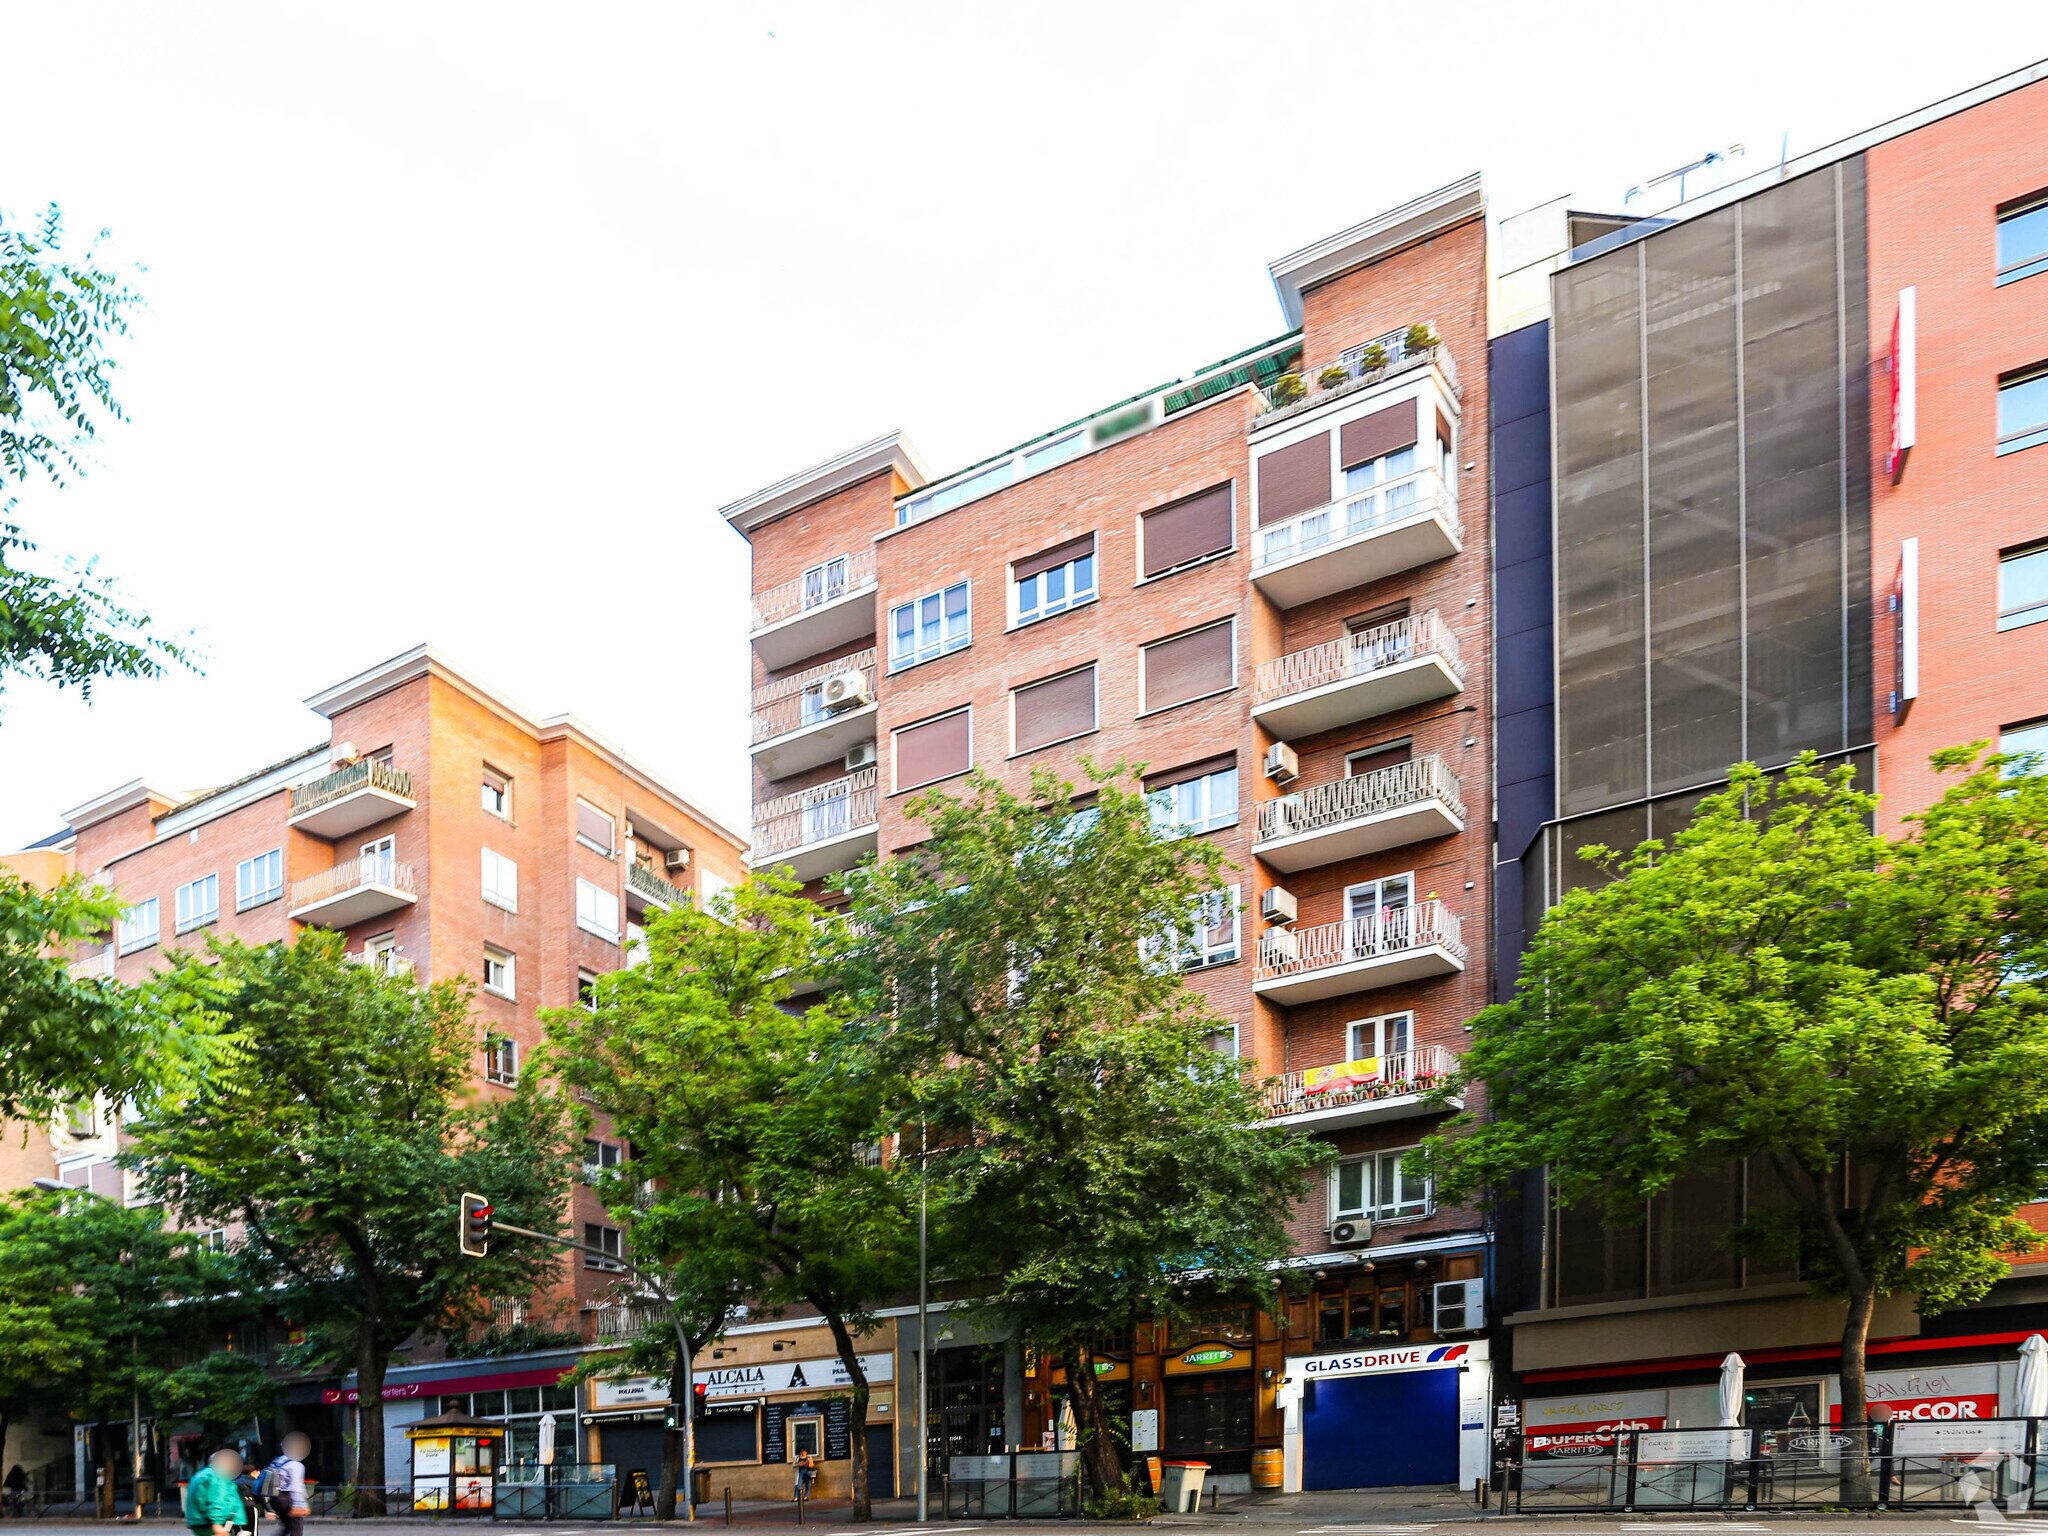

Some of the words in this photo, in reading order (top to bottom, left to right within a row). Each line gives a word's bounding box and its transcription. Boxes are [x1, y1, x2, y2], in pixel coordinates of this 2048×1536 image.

[1305, 1351, 1420, 1372] GLASSDRIVE
[707, 1367, 765, 1385] ALCALA
[1892, 1400, 1979, 1420] ERCOR
